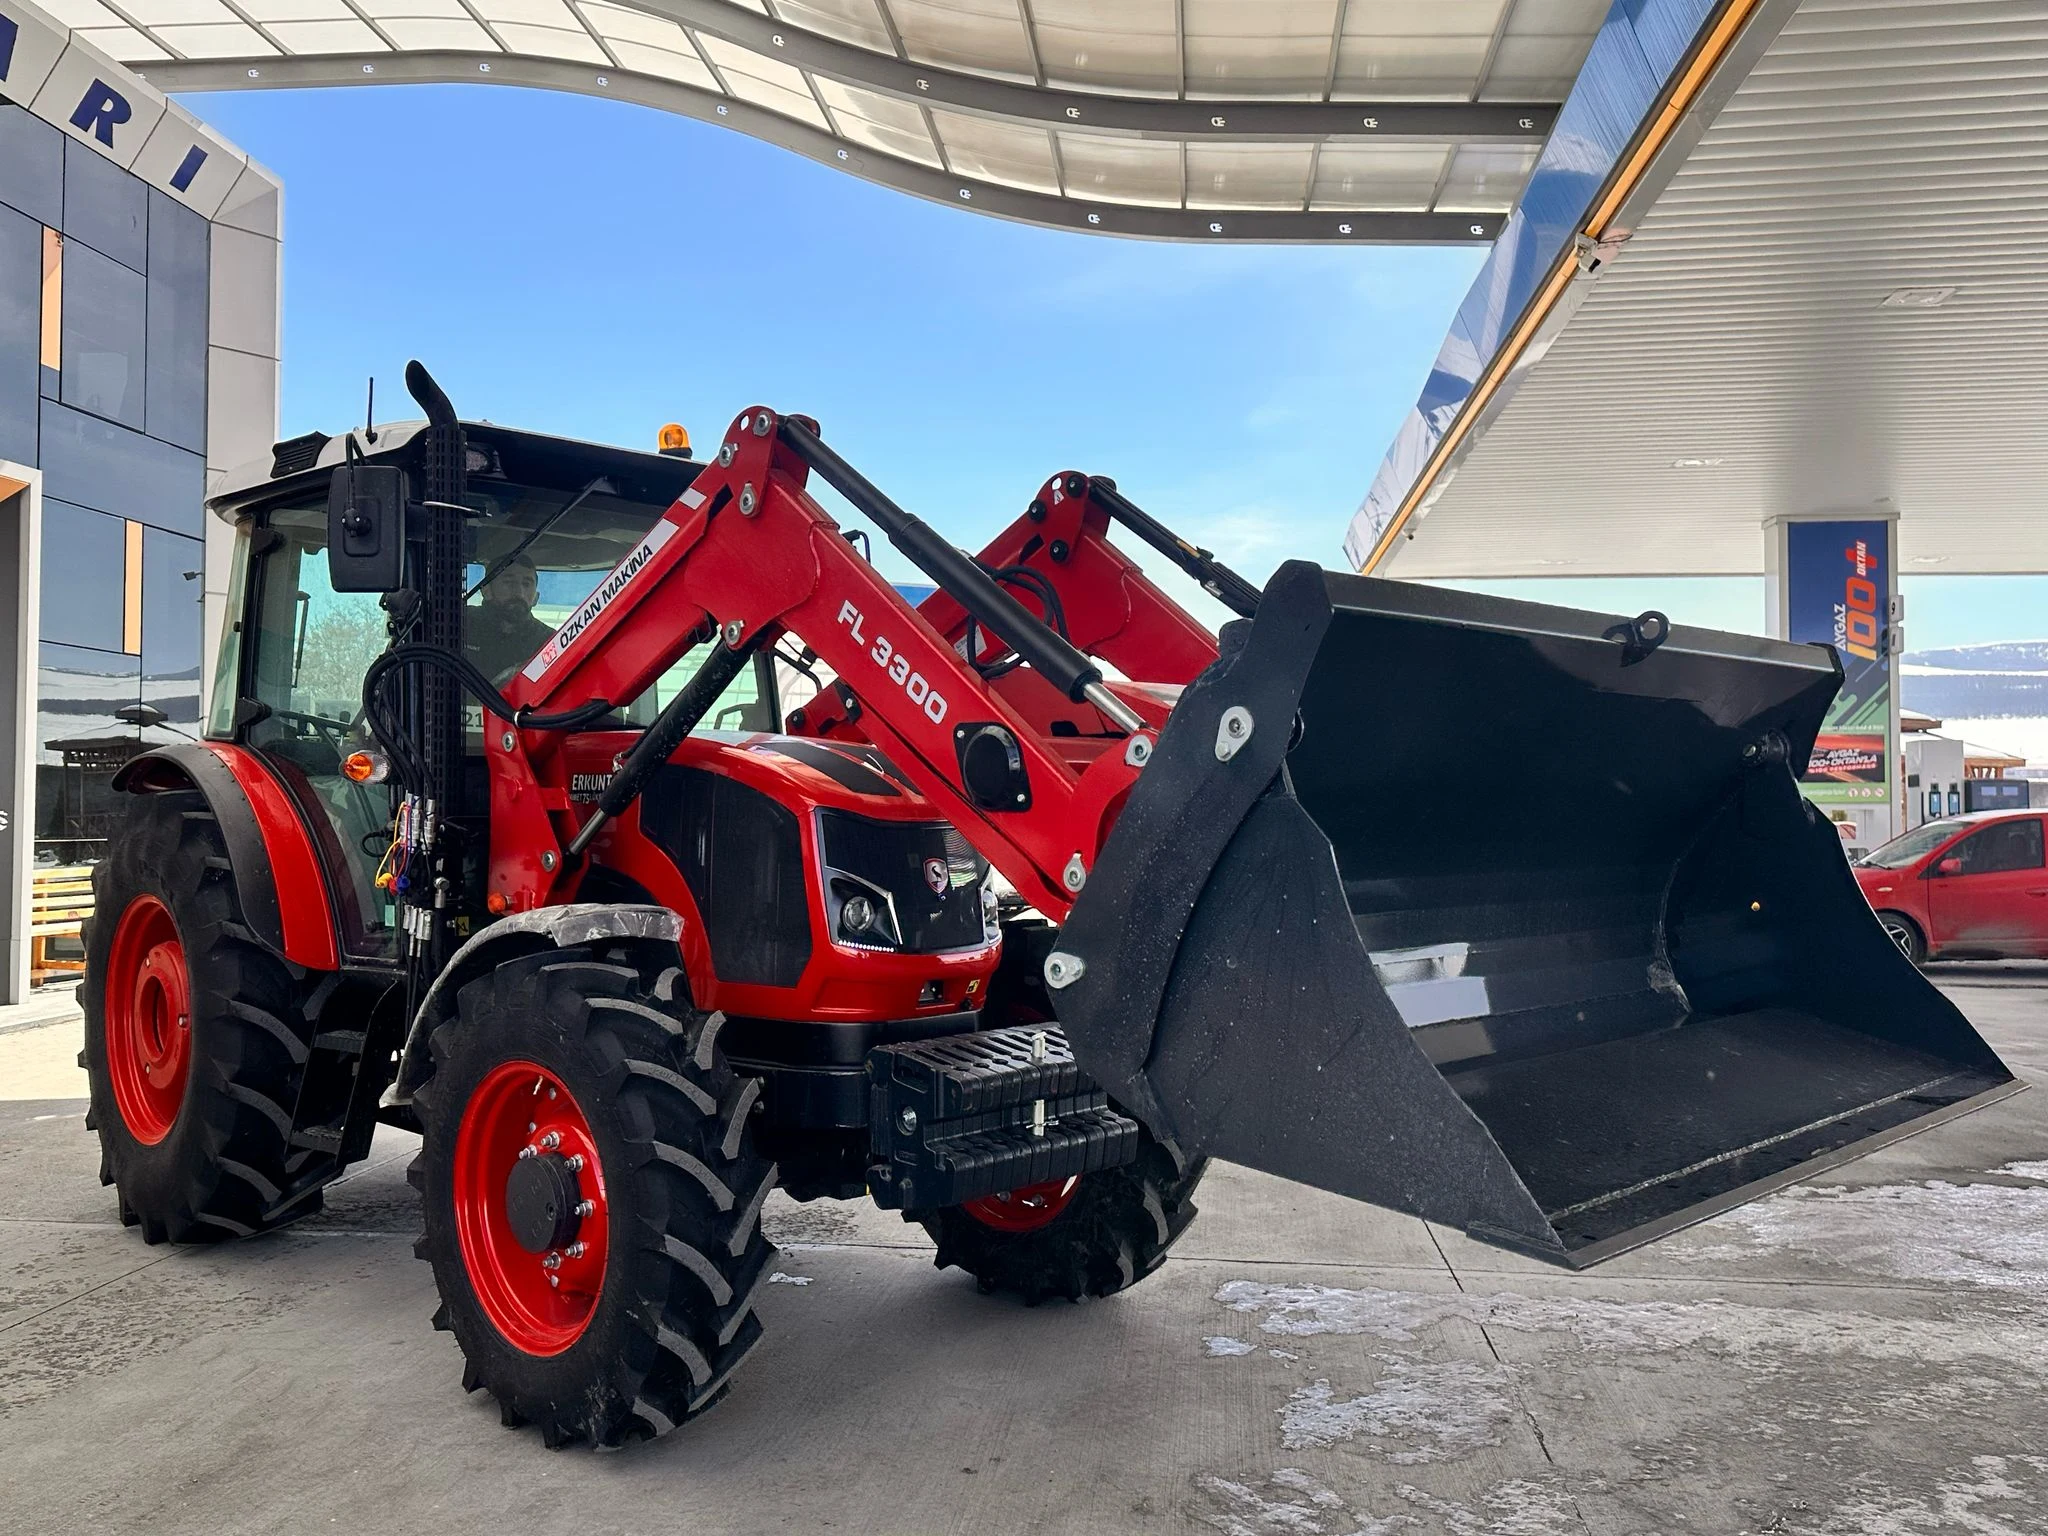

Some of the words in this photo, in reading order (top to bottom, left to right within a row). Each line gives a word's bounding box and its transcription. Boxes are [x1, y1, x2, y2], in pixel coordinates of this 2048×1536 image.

[1856, 541, 1867, 576] OKTAN
[559, 597, 601, 649] ÖZKAN
[602, 544, 653, 604] MAKİNA
[1834, 603, 1846, 651] AYGAZ
[837, 599, 865, 646] FL
[871, 636, 948, 724] 3300
[1827, 749, 1860, 759] AYGAZ
[572, 774, 612, 790] ERKUNT
